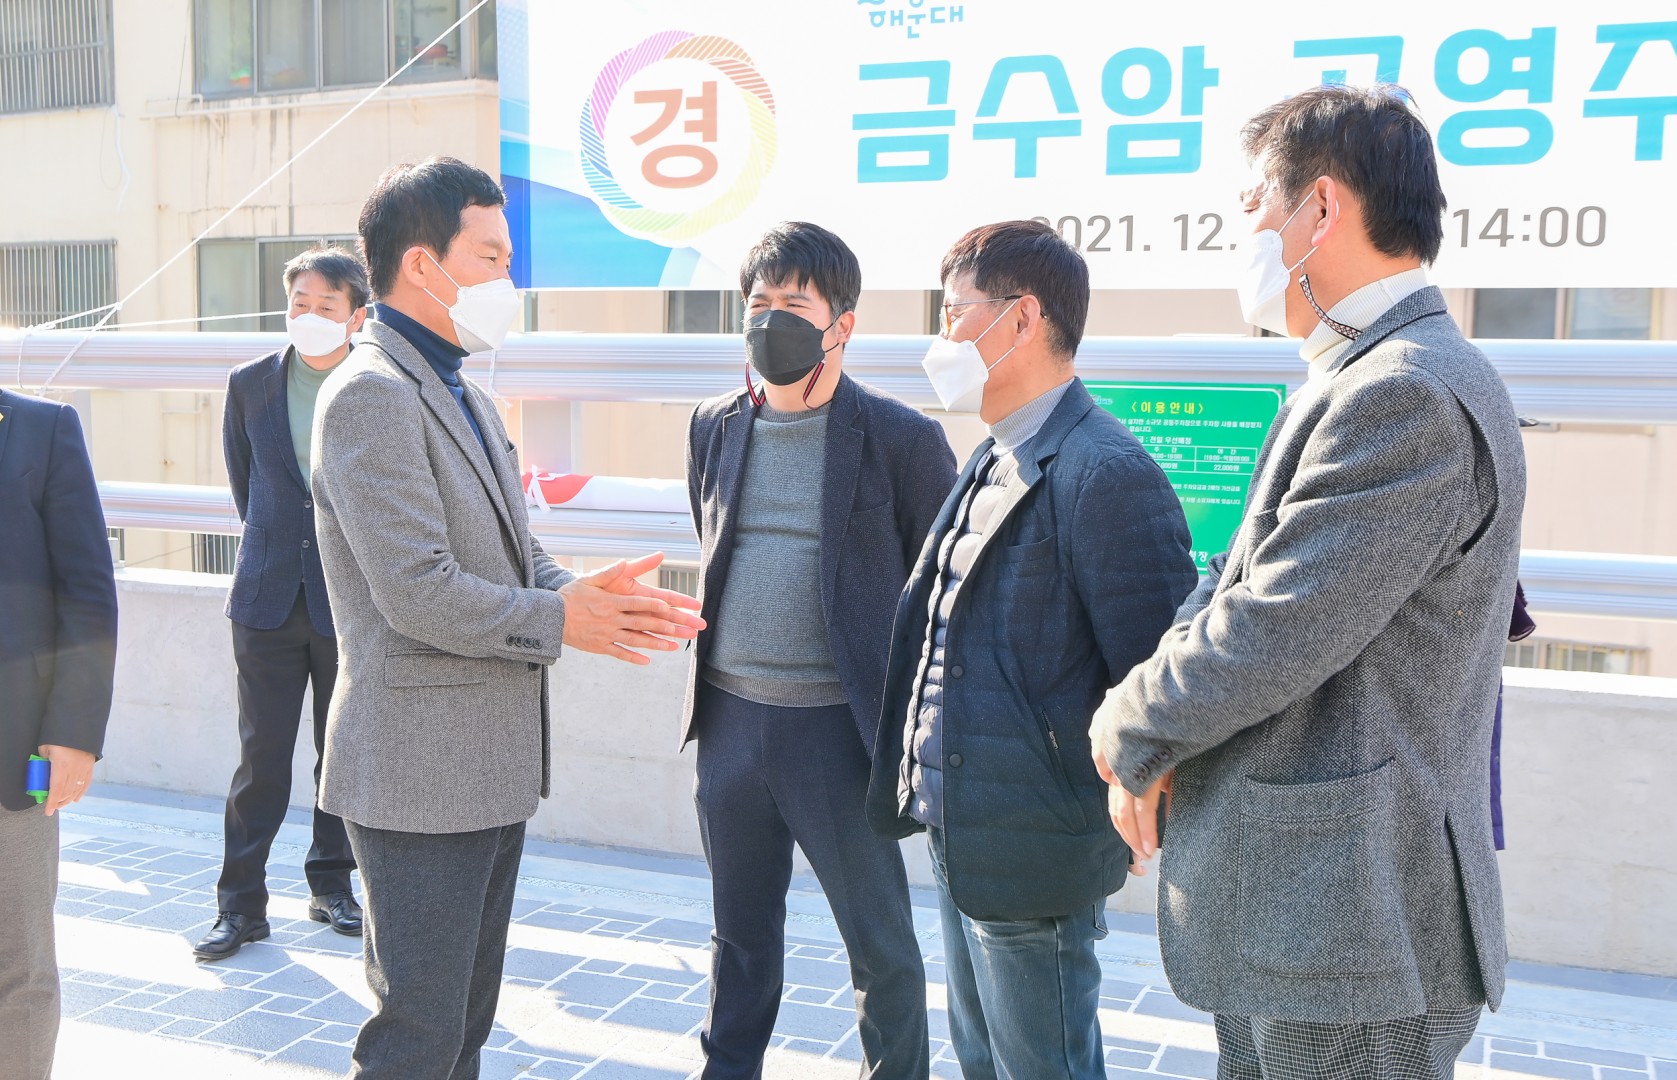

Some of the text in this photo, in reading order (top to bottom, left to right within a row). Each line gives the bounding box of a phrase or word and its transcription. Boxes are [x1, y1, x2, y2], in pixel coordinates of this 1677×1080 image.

[630, 80, 719, 190] 경
[851, 45, 1220, 184] 금수암
[1030, 214, 1151, 252] 021.
[1452, 205, 1608, 249] 14:00
